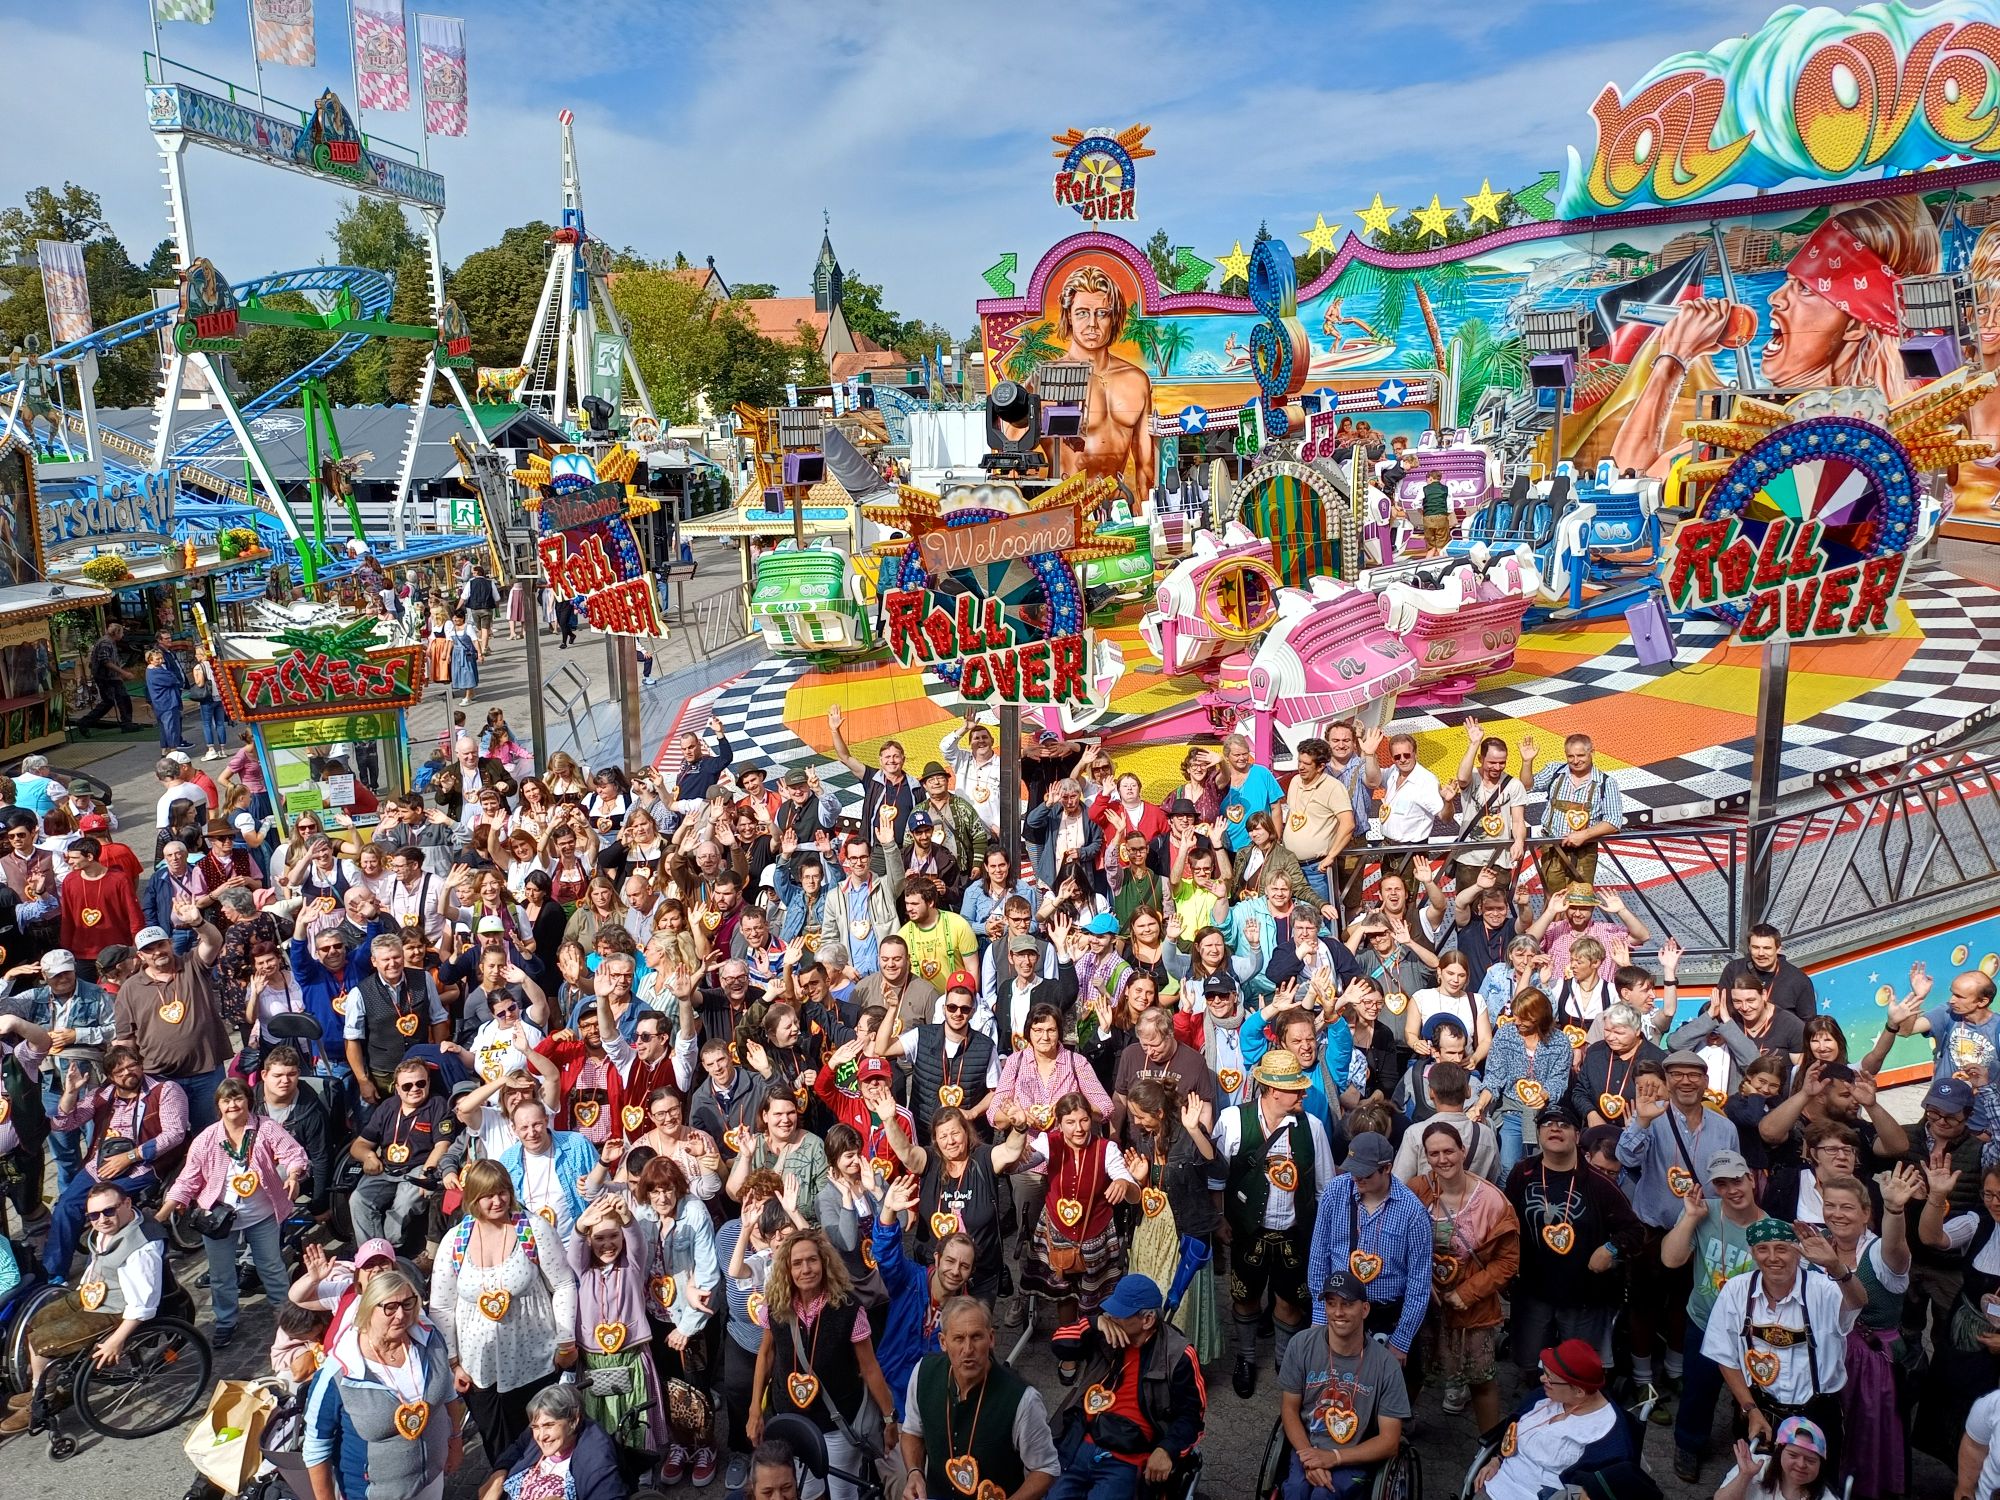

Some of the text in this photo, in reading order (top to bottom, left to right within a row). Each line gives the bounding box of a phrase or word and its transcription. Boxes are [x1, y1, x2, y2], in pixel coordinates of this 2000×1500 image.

[331, 142, 360, 162] HEIDI
[197, 310, 236, 338] HEIDI
[447, 336, 471, 357] HEIDI
[543, 495, 621, 528] Welcome
[926, 525, 1075, 570] Welcome
[245, 648, 408, 709] TICKETS
[1253, 674, 1265, 688] 10
